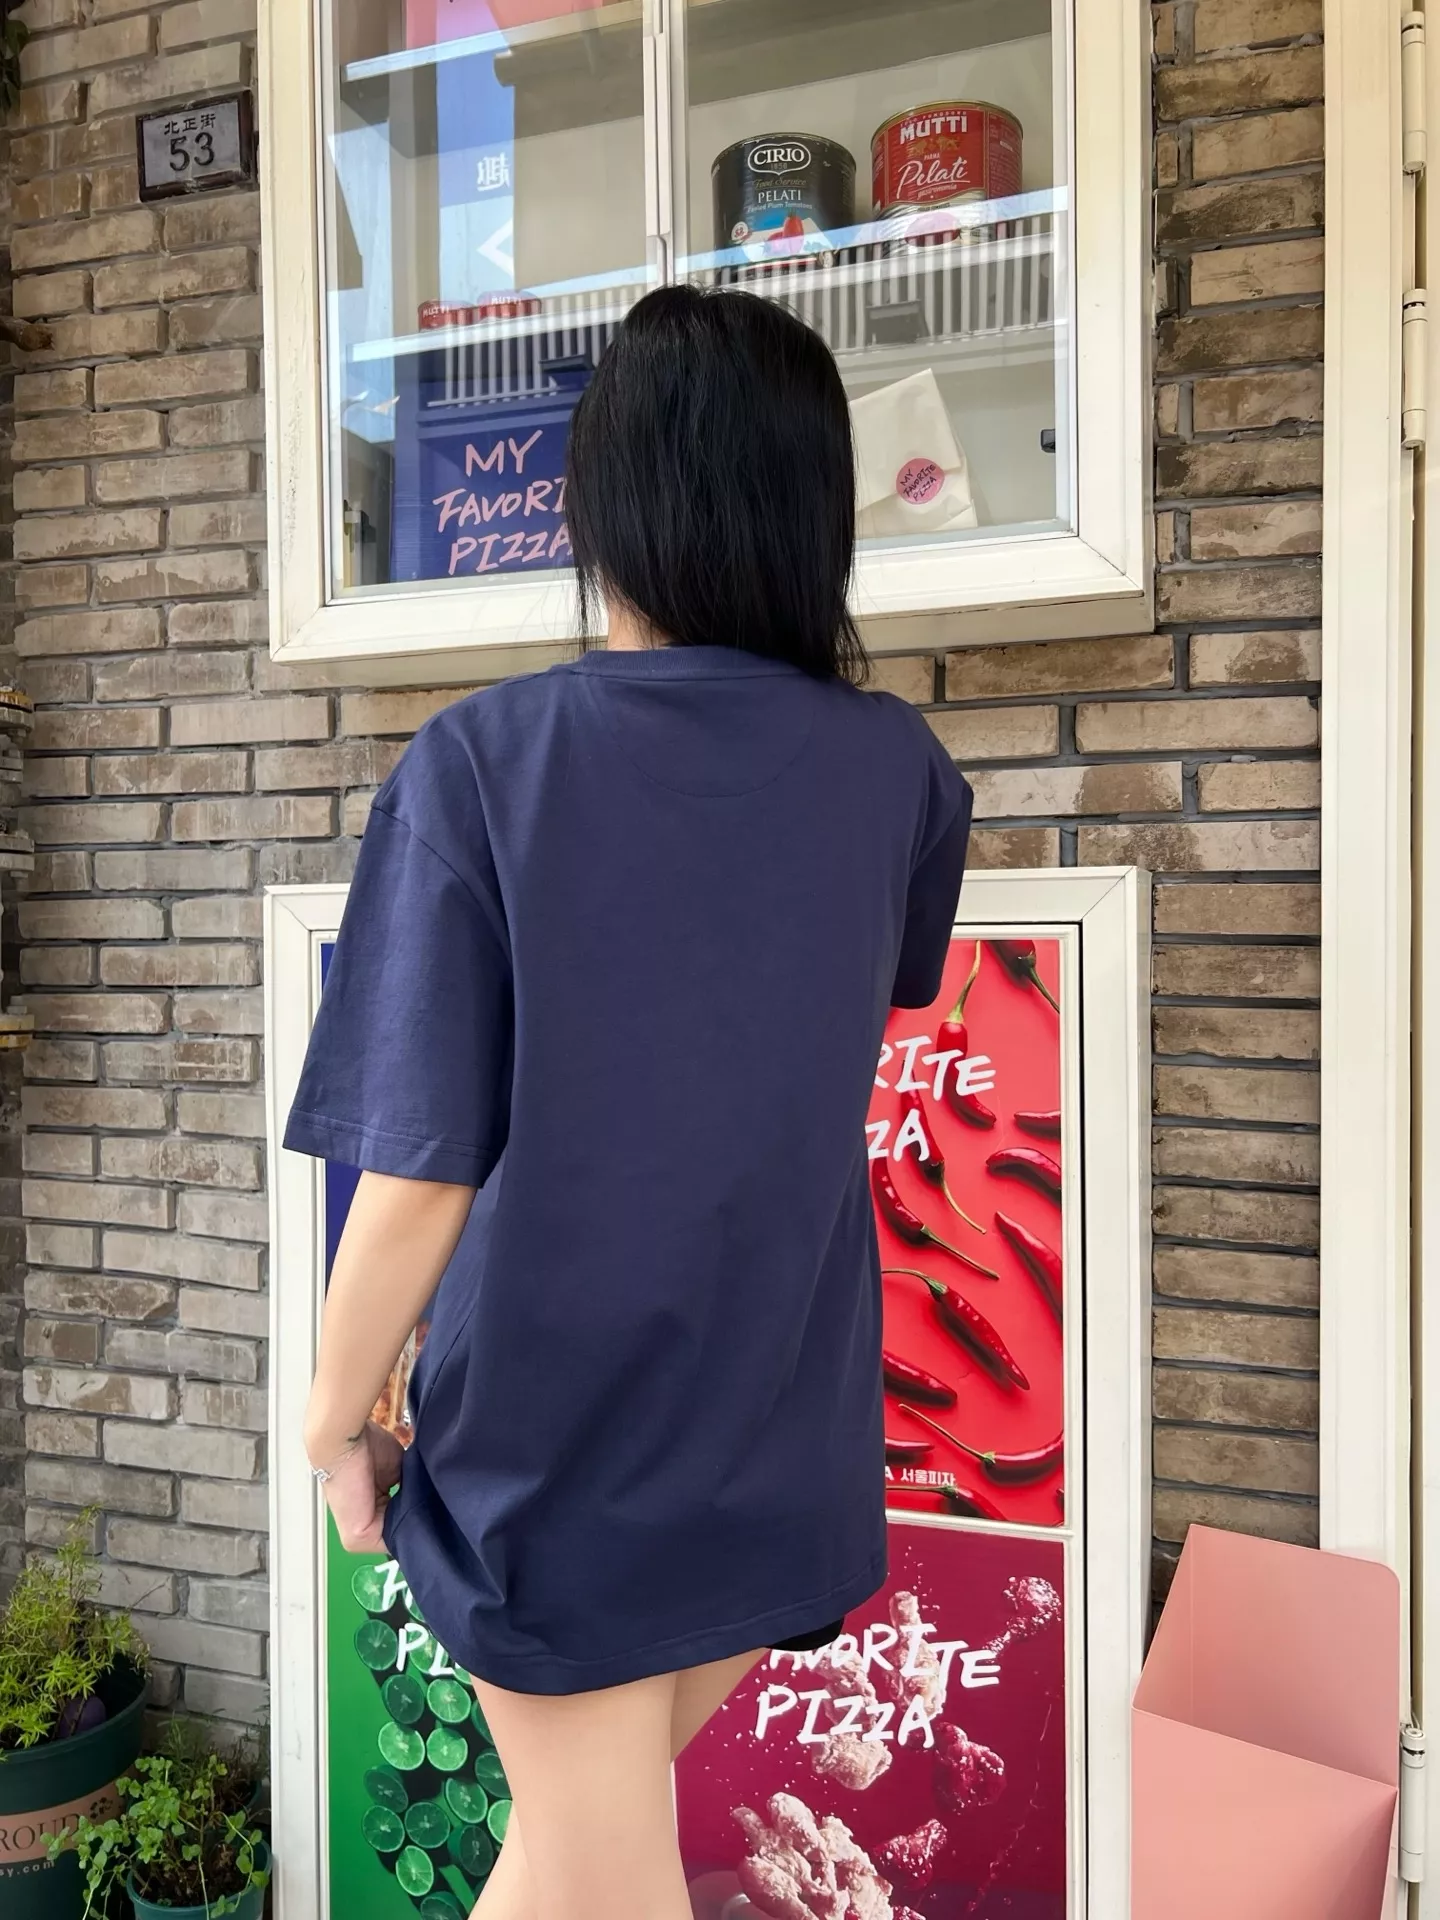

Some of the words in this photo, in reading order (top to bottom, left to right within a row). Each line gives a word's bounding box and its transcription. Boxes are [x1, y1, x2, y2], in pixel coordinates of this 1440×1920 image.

[163, 113, 216, 135] 北正街
[900, 115, 967, 145] MUTTI
[169, 132, 215, 171] 53
[753, 148, 805, 165] CIRIO
[896, 156, 970, 199] Pelati
[757, 189, 802, 203] PELATI
[465, 429, 543, 477] MY
[900, 468, 914, 486] MY
[903, 464, 937, 497] FAVORITE
[912, 476, 937, 501] PIZZA
[448, 522, 574, 575] PIZZA
[900, 1468, 956, 1487] 서울피자
[374, 1559, 413, 1611] F
[754, 1684, 935, 1748] PIZZA
